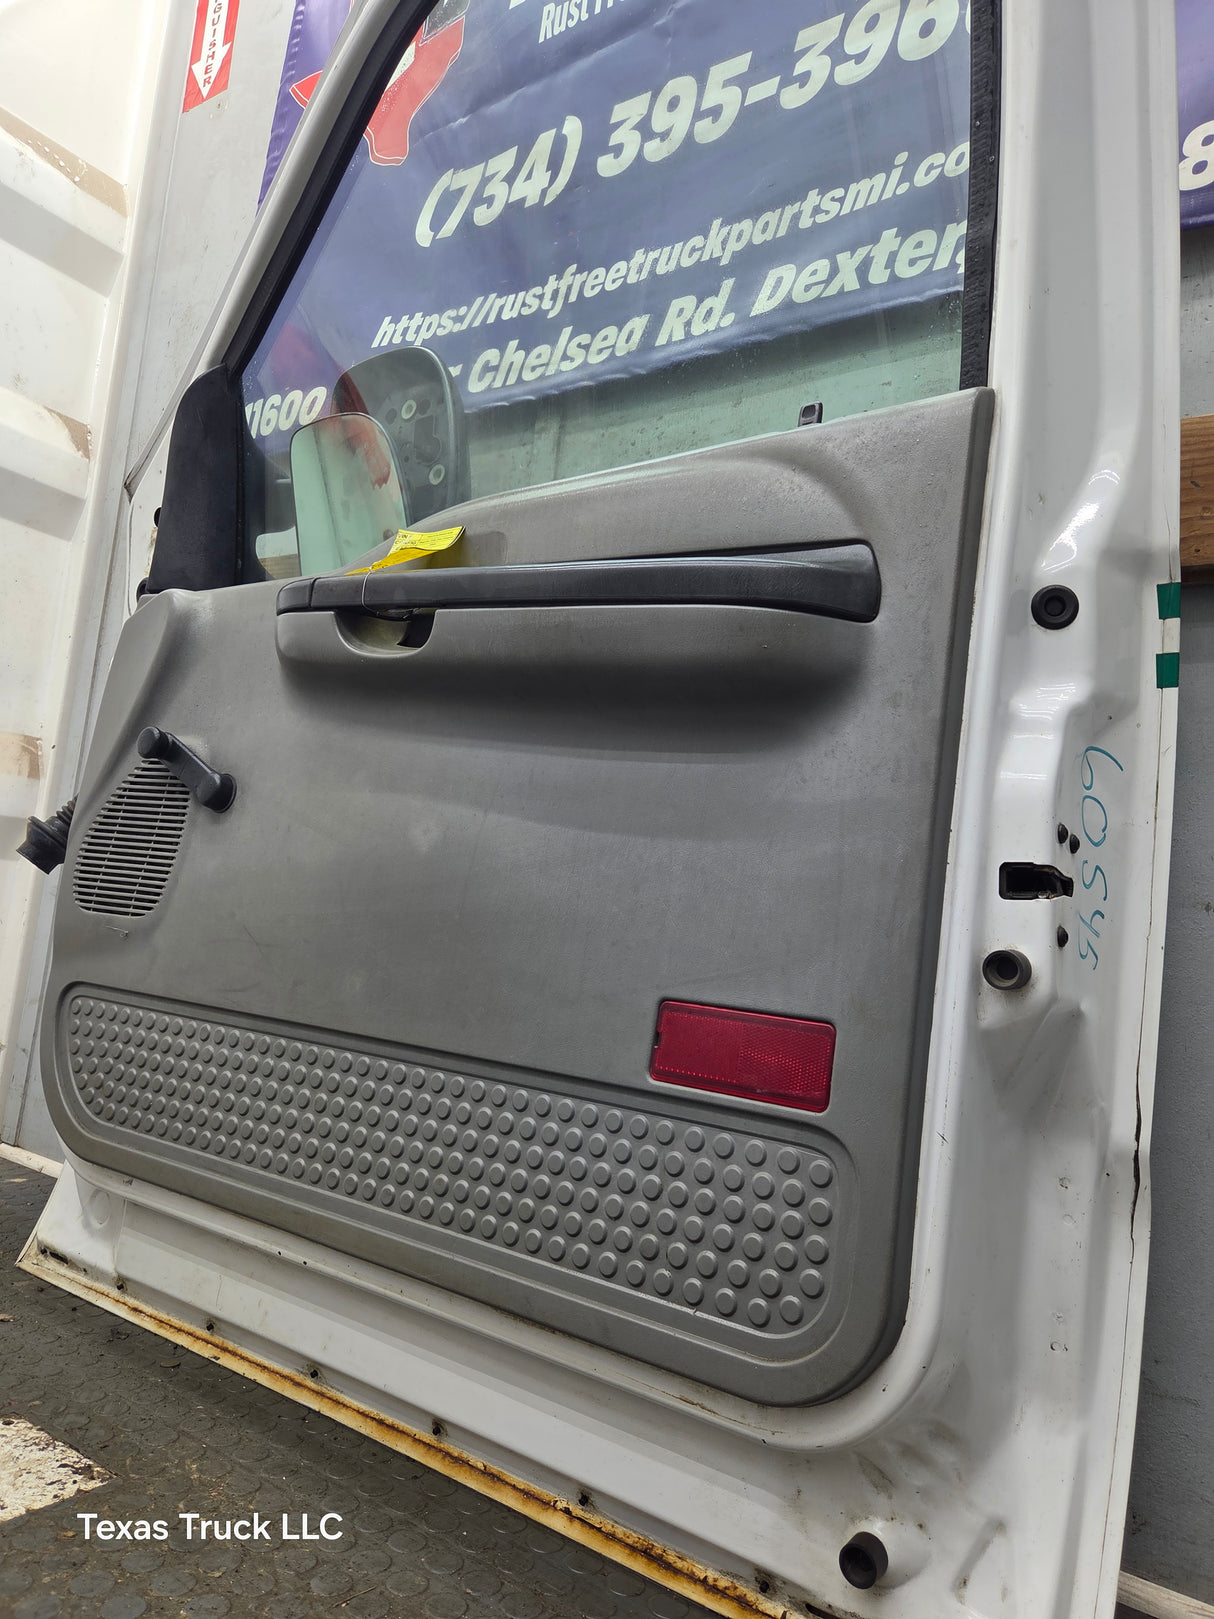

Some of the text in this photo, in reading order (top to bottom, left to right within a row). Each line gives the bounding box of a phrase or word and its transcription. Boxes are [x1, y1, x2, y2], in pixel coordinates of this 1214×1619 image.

[203, 0, 222, 88] GUISHER
[415, 0, 970, 247] (734) 395-396
[468, 313, 650, 393] Chelsea
[655, 277, 735, 347] Rd.
